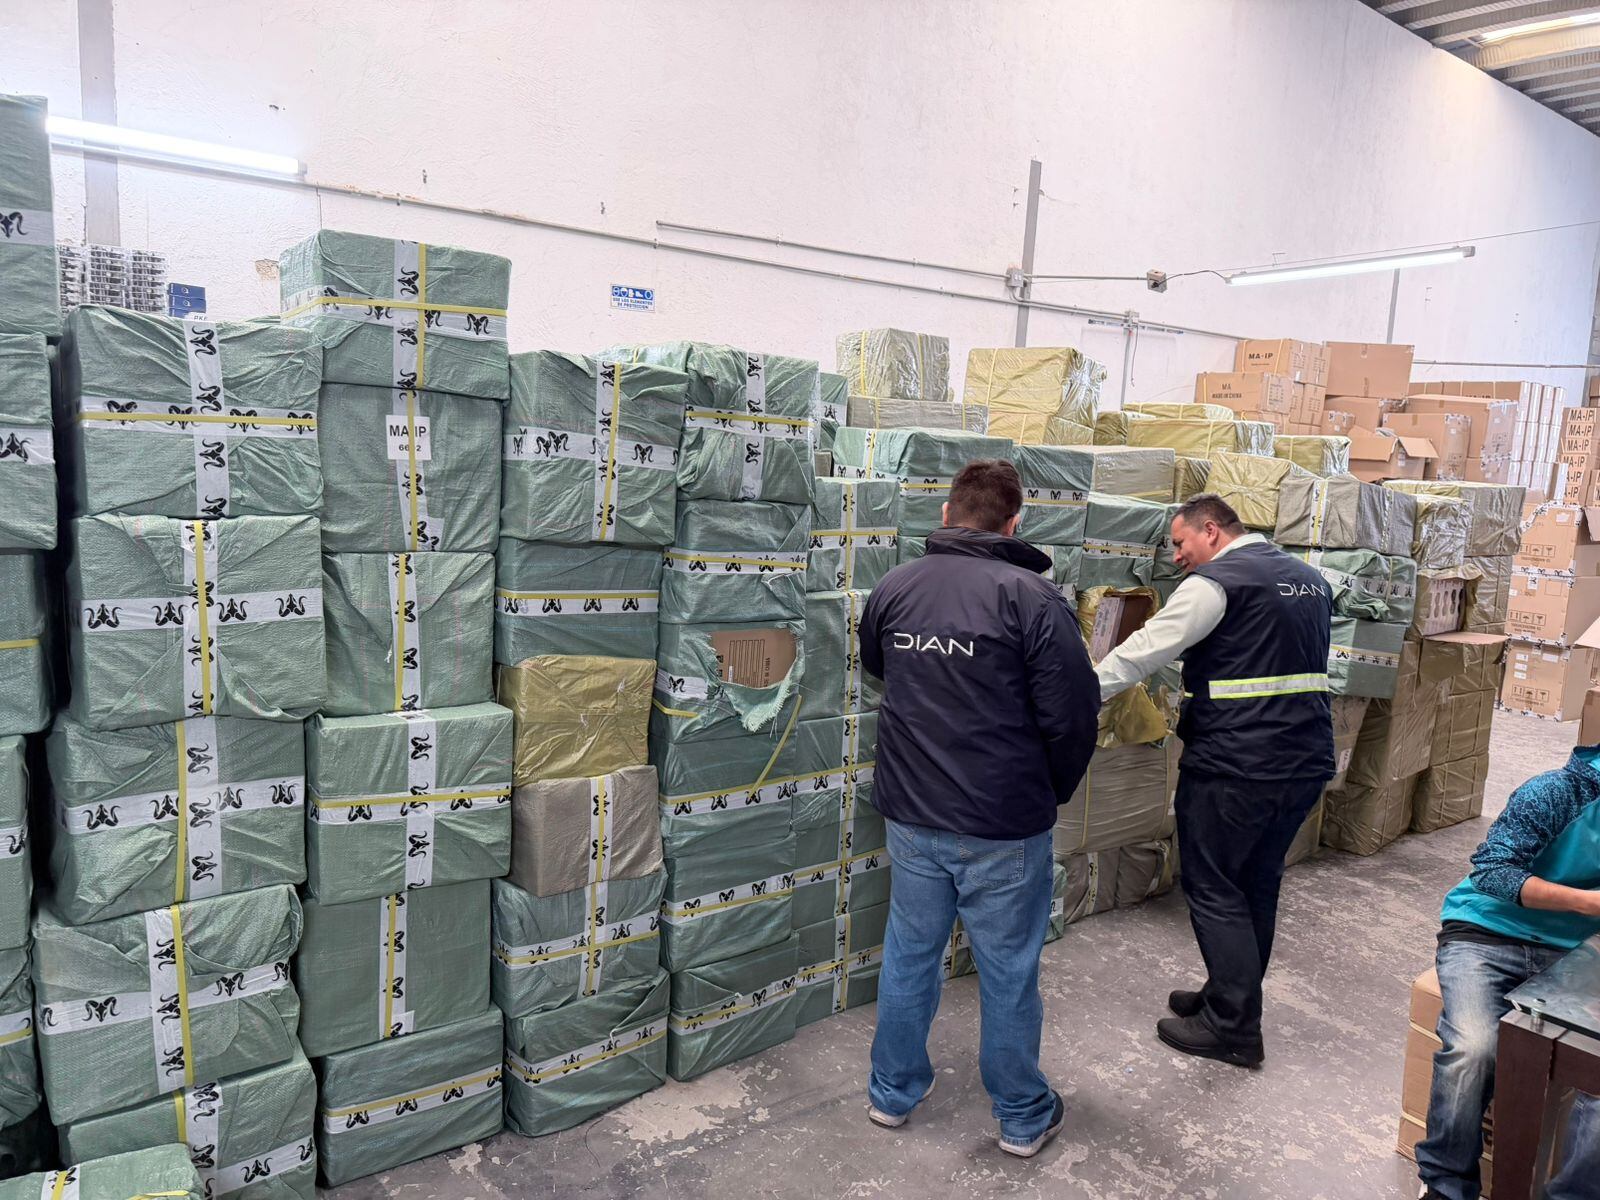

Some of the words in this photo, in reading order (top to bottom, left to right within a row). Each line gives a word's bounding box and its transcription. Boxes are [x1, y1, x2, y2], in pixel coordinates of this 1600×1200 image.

[1570, 409, 1594, 420] MA-IP
[1569, 424, 1592, 436] MA-IP
[1567, 439, 1589, 451] MA-IP
[1276, 583, 1326, 597] DIAN
[894, 632, 974, 657] DIAN
